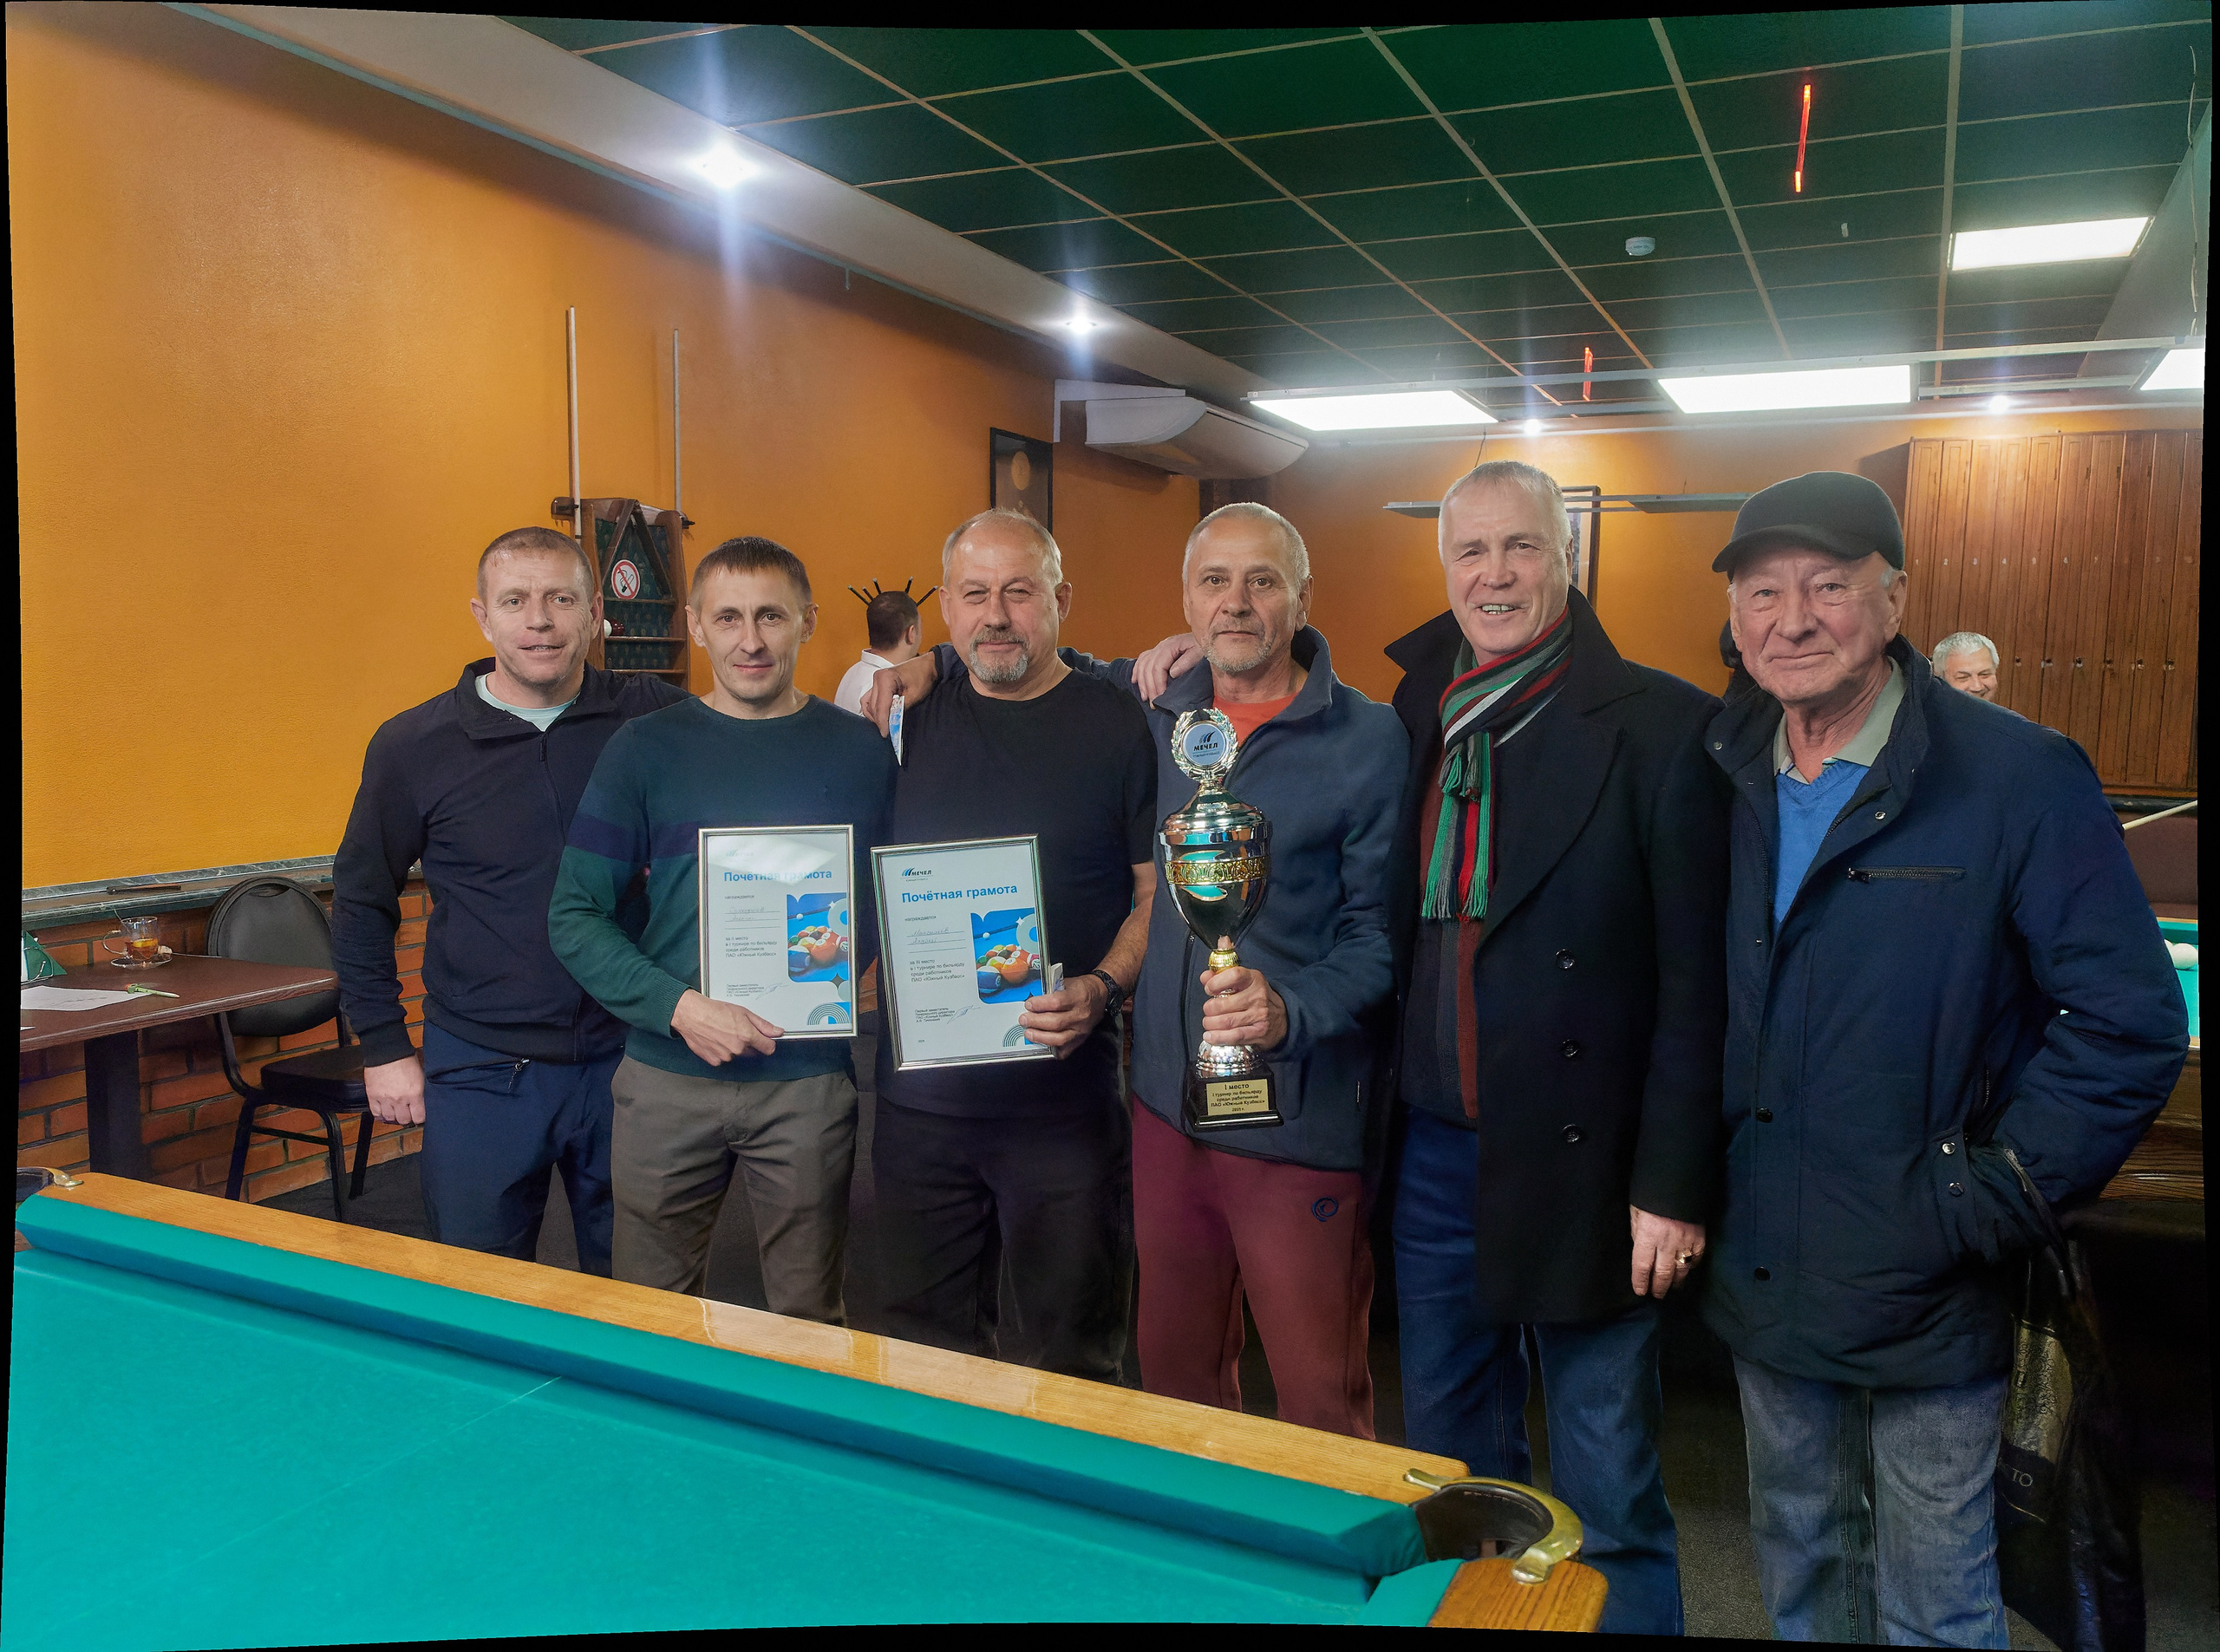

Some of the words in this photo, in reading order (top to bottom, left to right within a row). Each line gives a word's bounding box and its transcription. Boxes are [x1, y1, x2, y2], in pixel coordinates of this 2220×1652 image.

[1194, 742, 1218, 751] МЕЧЕЛ
[902, 891, 963, 903] Почётная
[966, 885, 1017, 899] грамота
